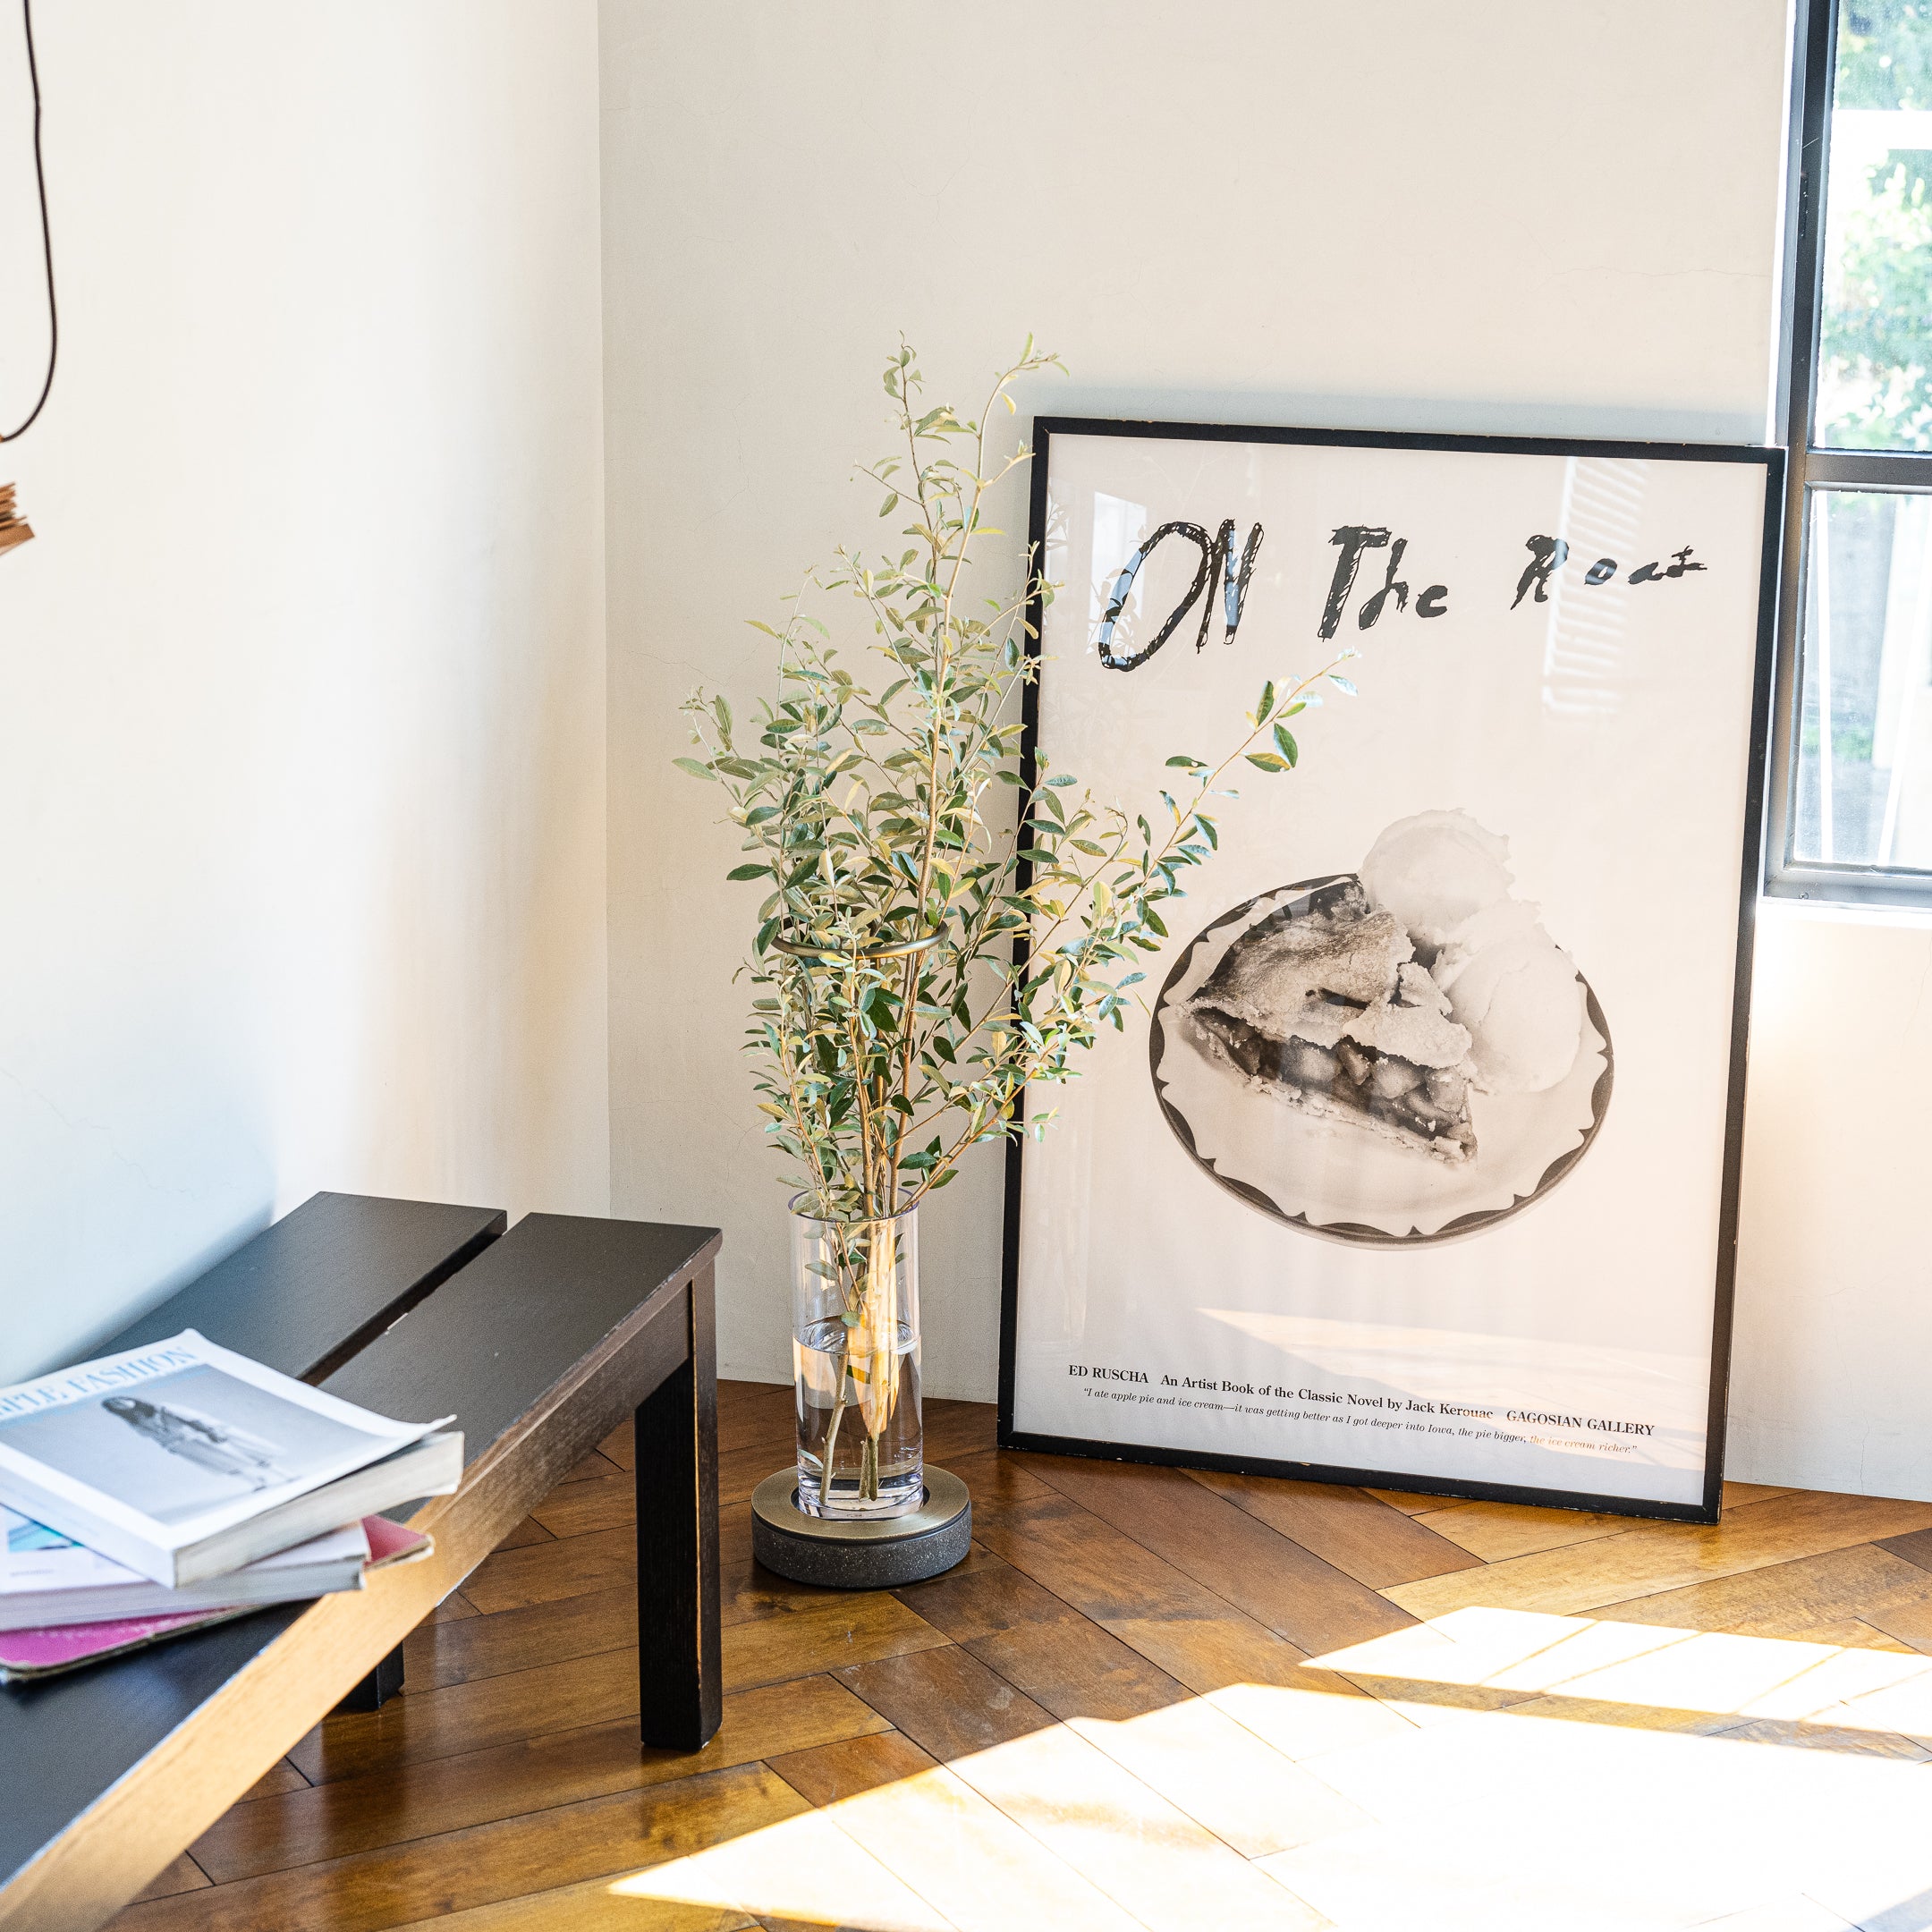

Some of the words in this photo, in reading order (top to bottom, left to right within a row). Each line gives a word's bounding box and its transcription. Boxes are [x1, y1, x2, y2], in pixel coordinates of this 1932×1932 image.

[1099, 519, 1265, 673] ON
[1317, 524, 1449, 642] The
[66, 1346, 197, 1394] FASHION
[1068, 1364, 1089, 1377] ED
[1092, 1367, 1149, 1384] RUSCHA
[1160, 1374, 1178, 1386] An
[1182, 1377, 1218, 1391] Artist
[1222, 1380, 1255, 1394] Book
[1258, 1385, 1271, 1396] of
[1275, 1386, 1294, 1399] the
[1298, 1388, 1343, 1403] Classic
[1347, 1394, 1383, 1408] Novel
[1387, 1398, 1402, 1411] by
[1405, 1400, 1435, 1413] Jack
[1439, 1403, 1494, 1419] Kerouac
[1506, 1410, 1582, 1428] GAGOSIAN
[1587, 1419, 1655, 1436] GALLERY
[1094, 1389, 1109, 1399] ate
[1111, 1392, 1137, 1402] apple
[1139, 1394, 1155, 1404] pie
[1157, 1396, 1176, 1406] and
[1178, 1397, 1192, 1408] ice
[1244, 1405, 1265, 1415] was
[1267, 1407, 1301, 1420] getting
[1302, 1411, 1331, 1422] better
[1332, 1415, 1344, 1424] as
[1345, 1415, 1352, 1425] I
[1352, 1417, 1368, 1427] got
[1370, 1418, 1403, 1430] deeper
[1405, 1421, 1426, 1432] into
[1428, 1424, 1455, 1436] Iowa,
[1458, 1428, 1474, 1437] the
[1475, 1429, 1492, 1440] pie
[1494, 1431, 1528, 1445] bigger,
[1530, 1435, 1546, 1445] the
[1547, 1436, 1563, 1447] ice
[1564, 1439, 1596, 1450] cream
